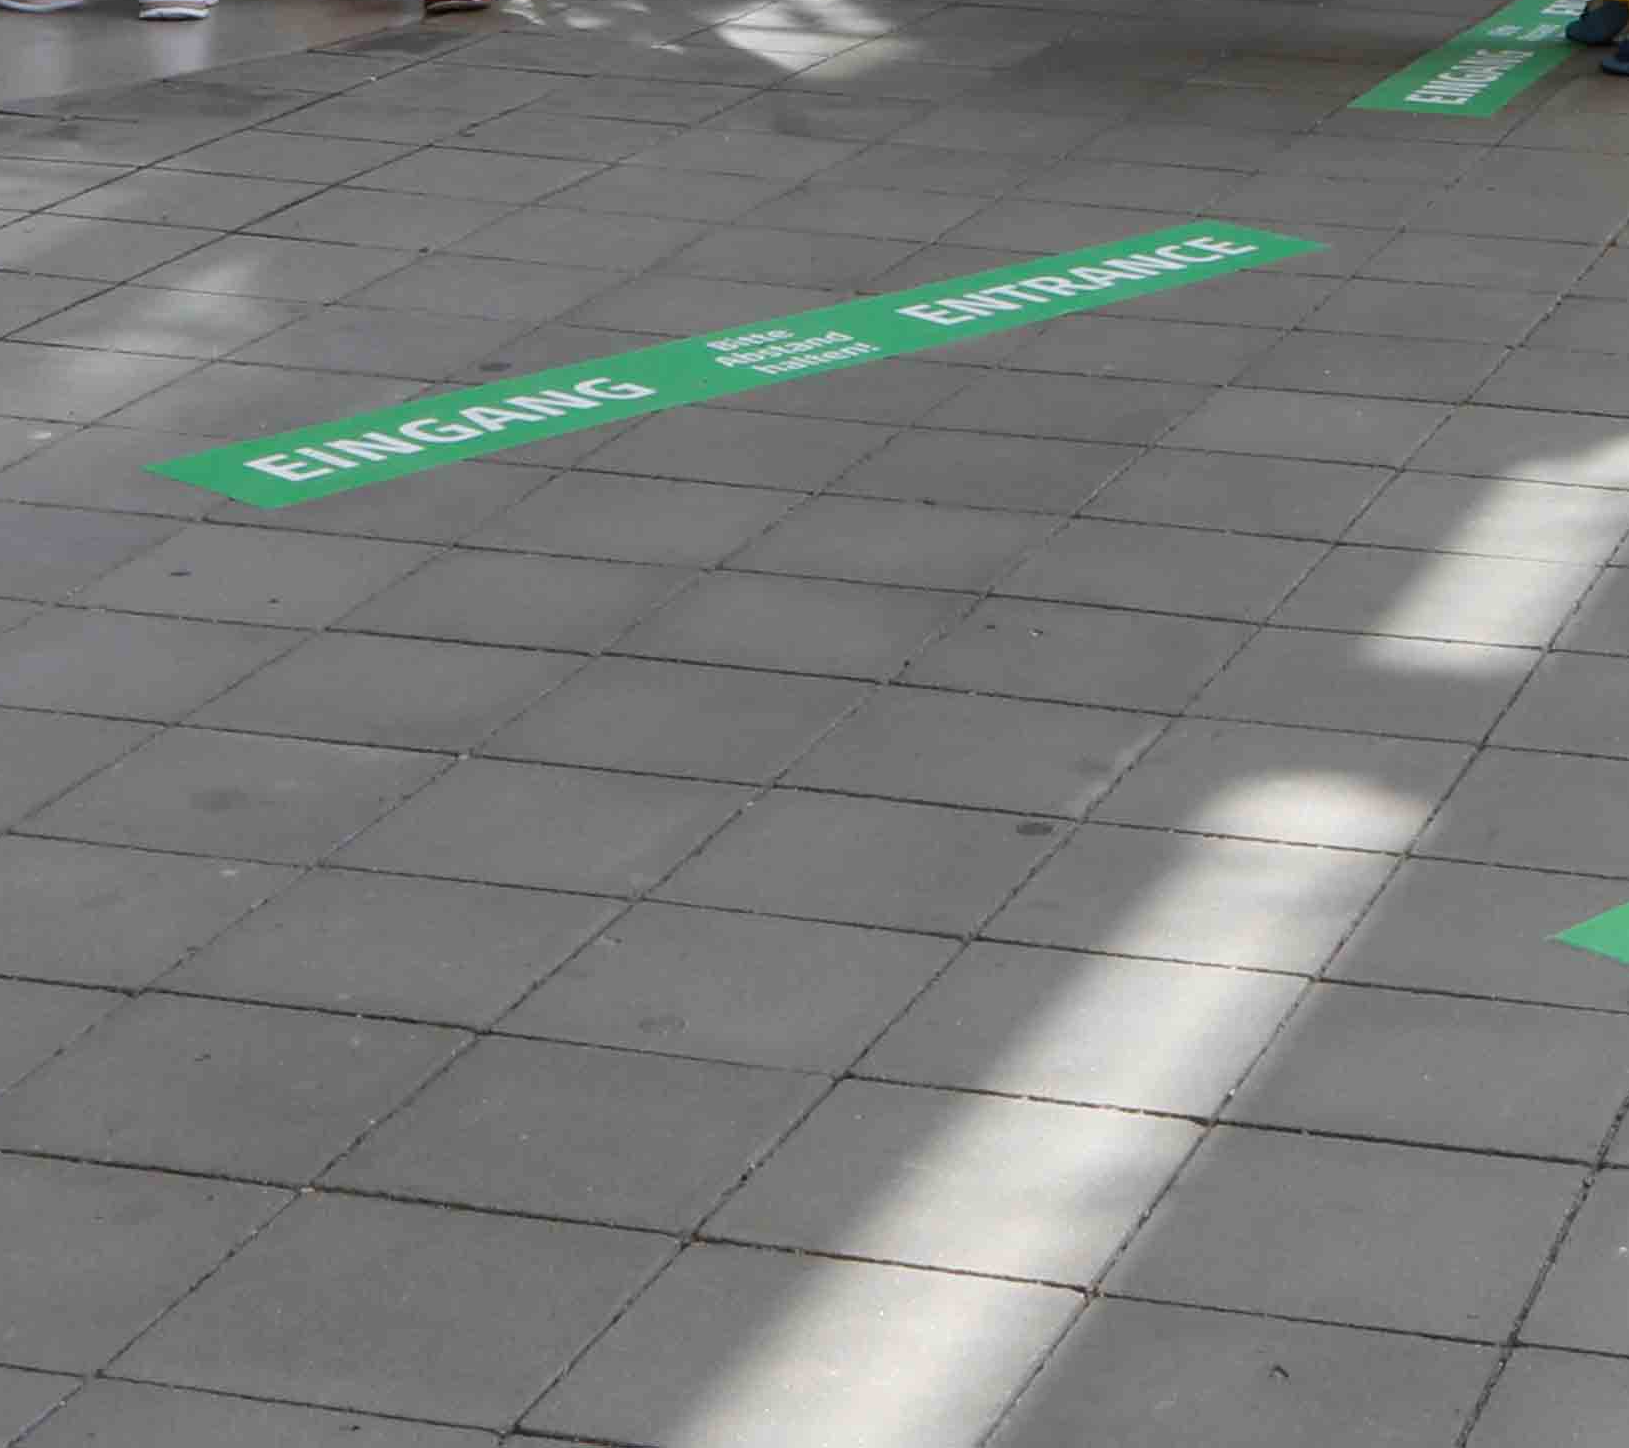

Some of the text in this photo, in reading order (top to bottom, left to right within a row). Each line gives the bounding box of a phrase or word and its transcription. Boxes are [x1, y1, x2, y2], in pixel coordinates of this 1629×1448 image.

[894, 236, 1259, 326] ENTRANCE
[706, 330, 794, 352] Bitte
[714, 330, 856, 369] Abstand
[751, 341, 882, 375] halten!
[247, 377, 660, 484] EINGANG
